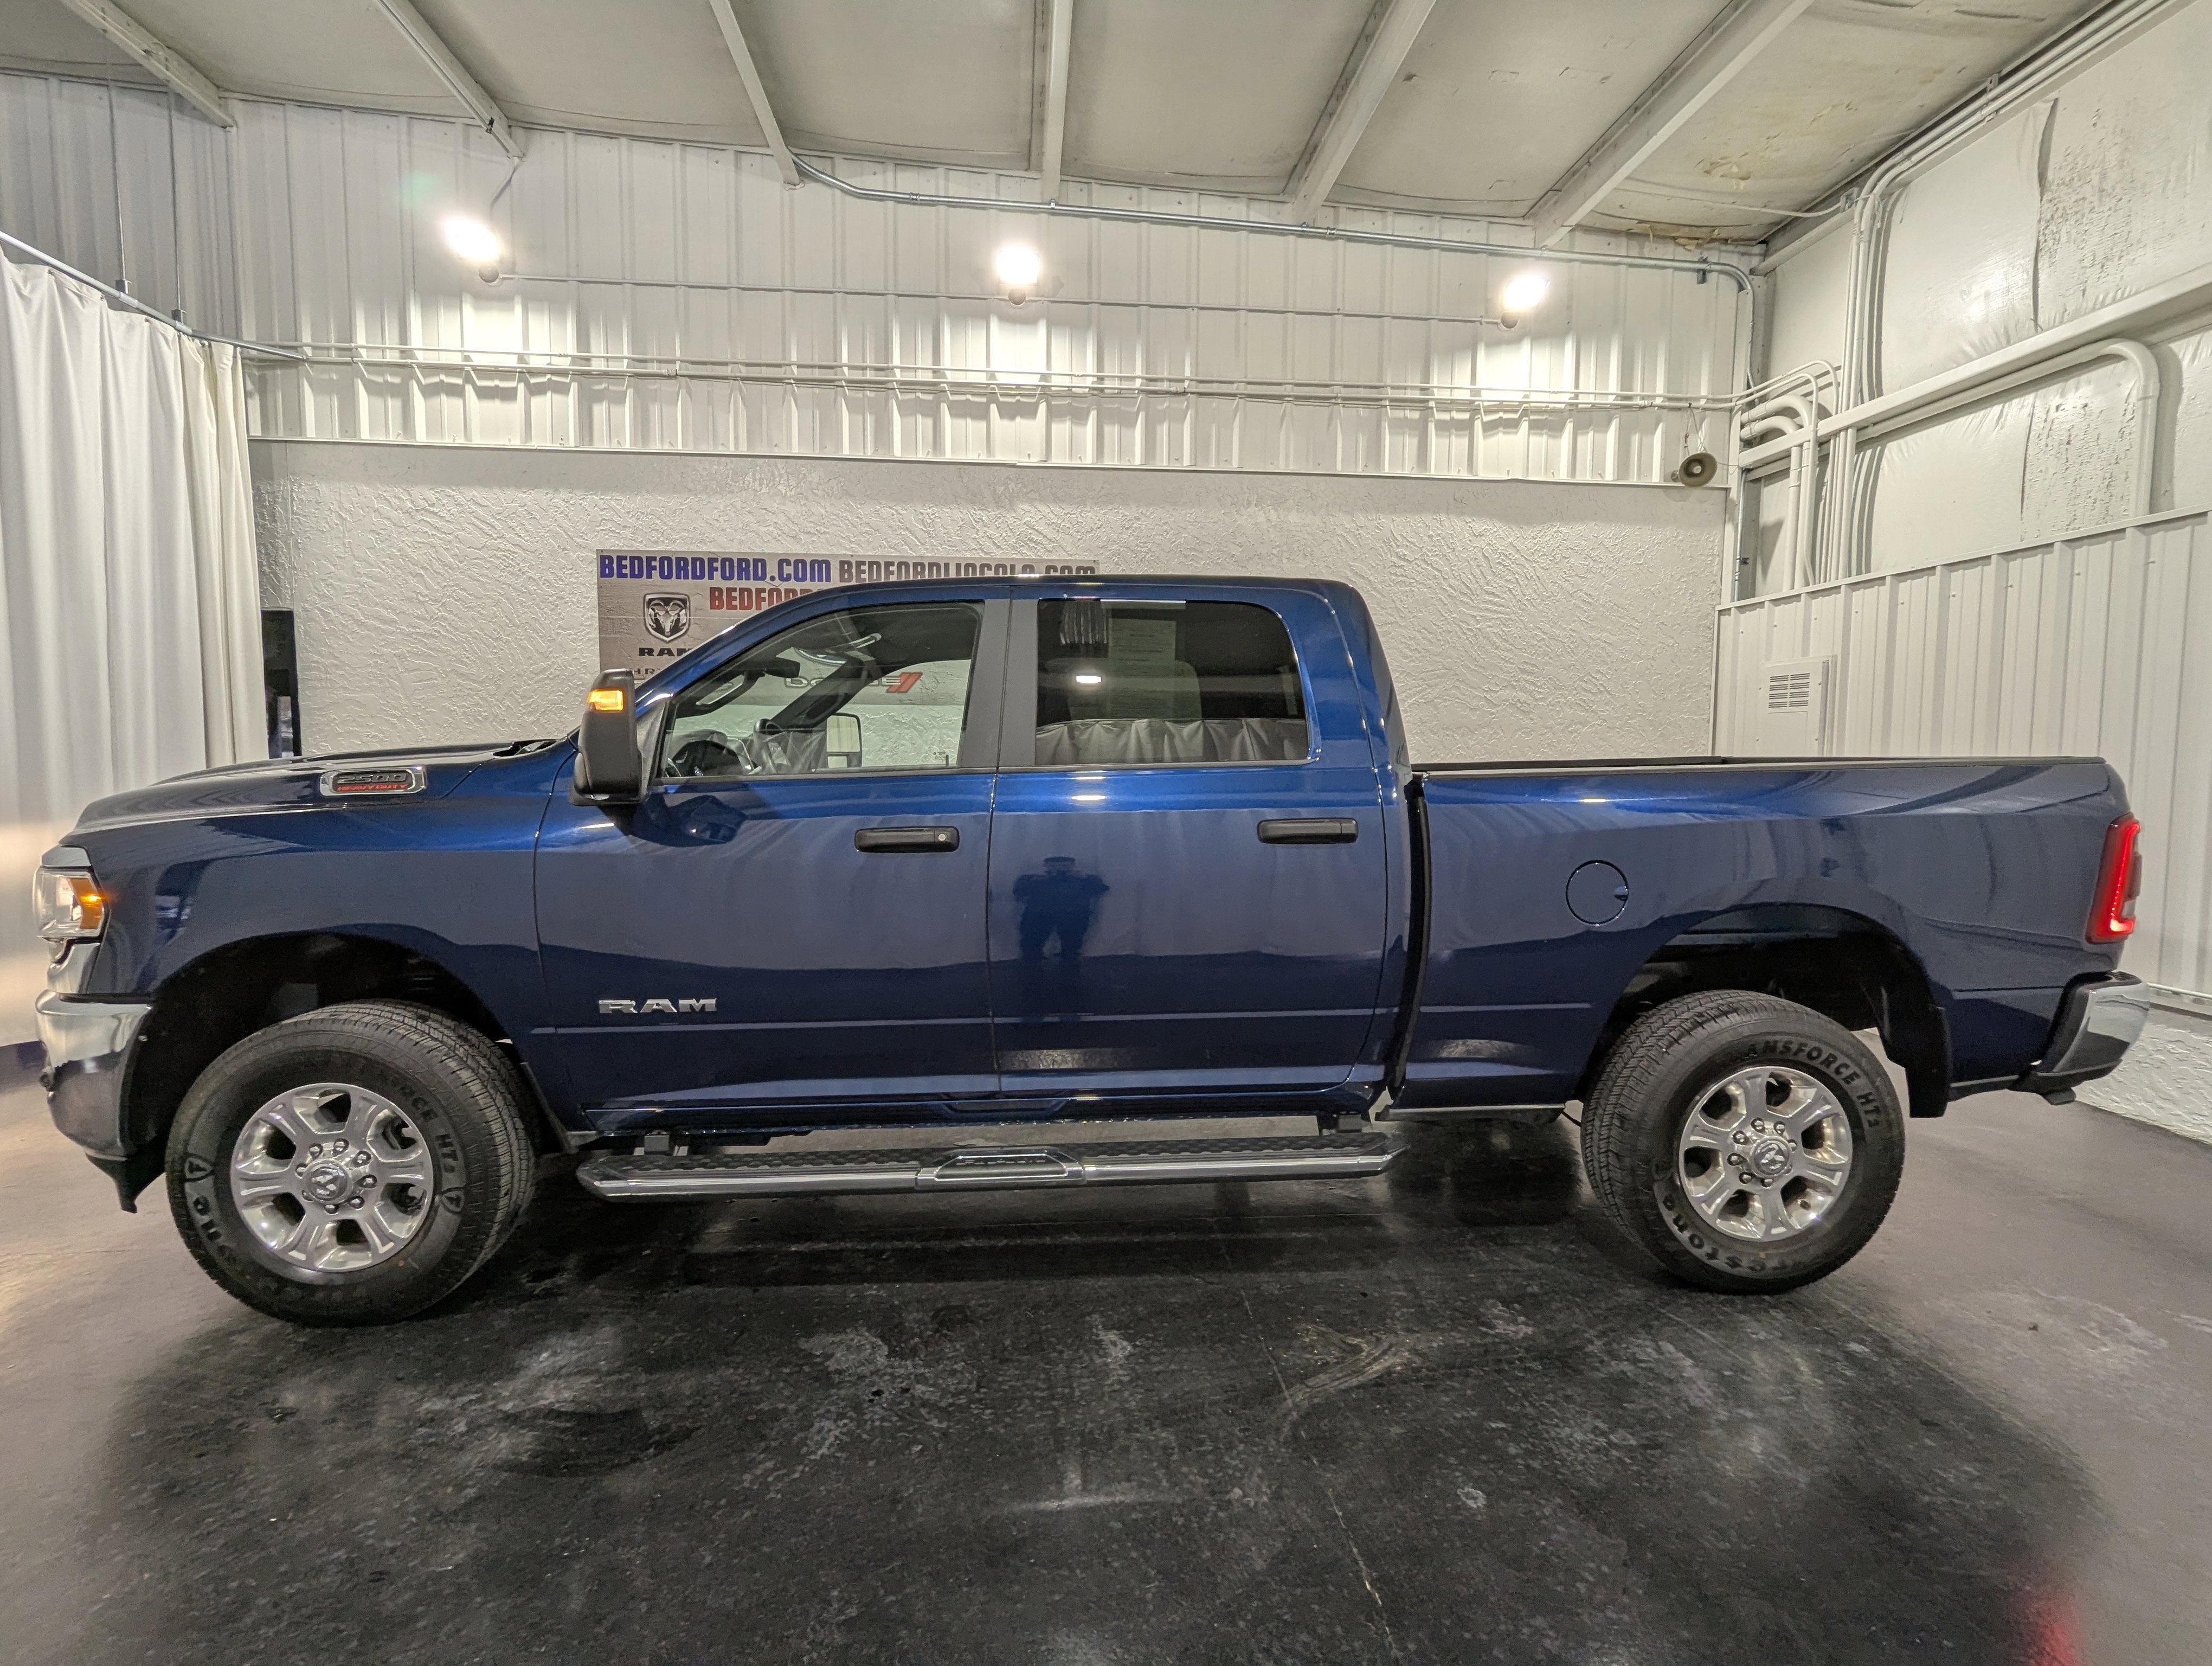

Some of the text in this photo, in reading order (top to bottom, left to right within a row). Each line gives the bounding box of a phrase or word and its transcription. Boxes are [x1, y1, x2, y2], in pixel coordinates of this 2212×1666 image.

[600, 555, 1096, 584] BEDFORDFORD.COM BEDFORDLINCO
[337, 772, 407, 784] 2500
[598, 998, 717, 1014] RAM
[1745, 1039, 1860, 1085] ANSFORCE
[1662, 1194, 1790, 1272] restone
